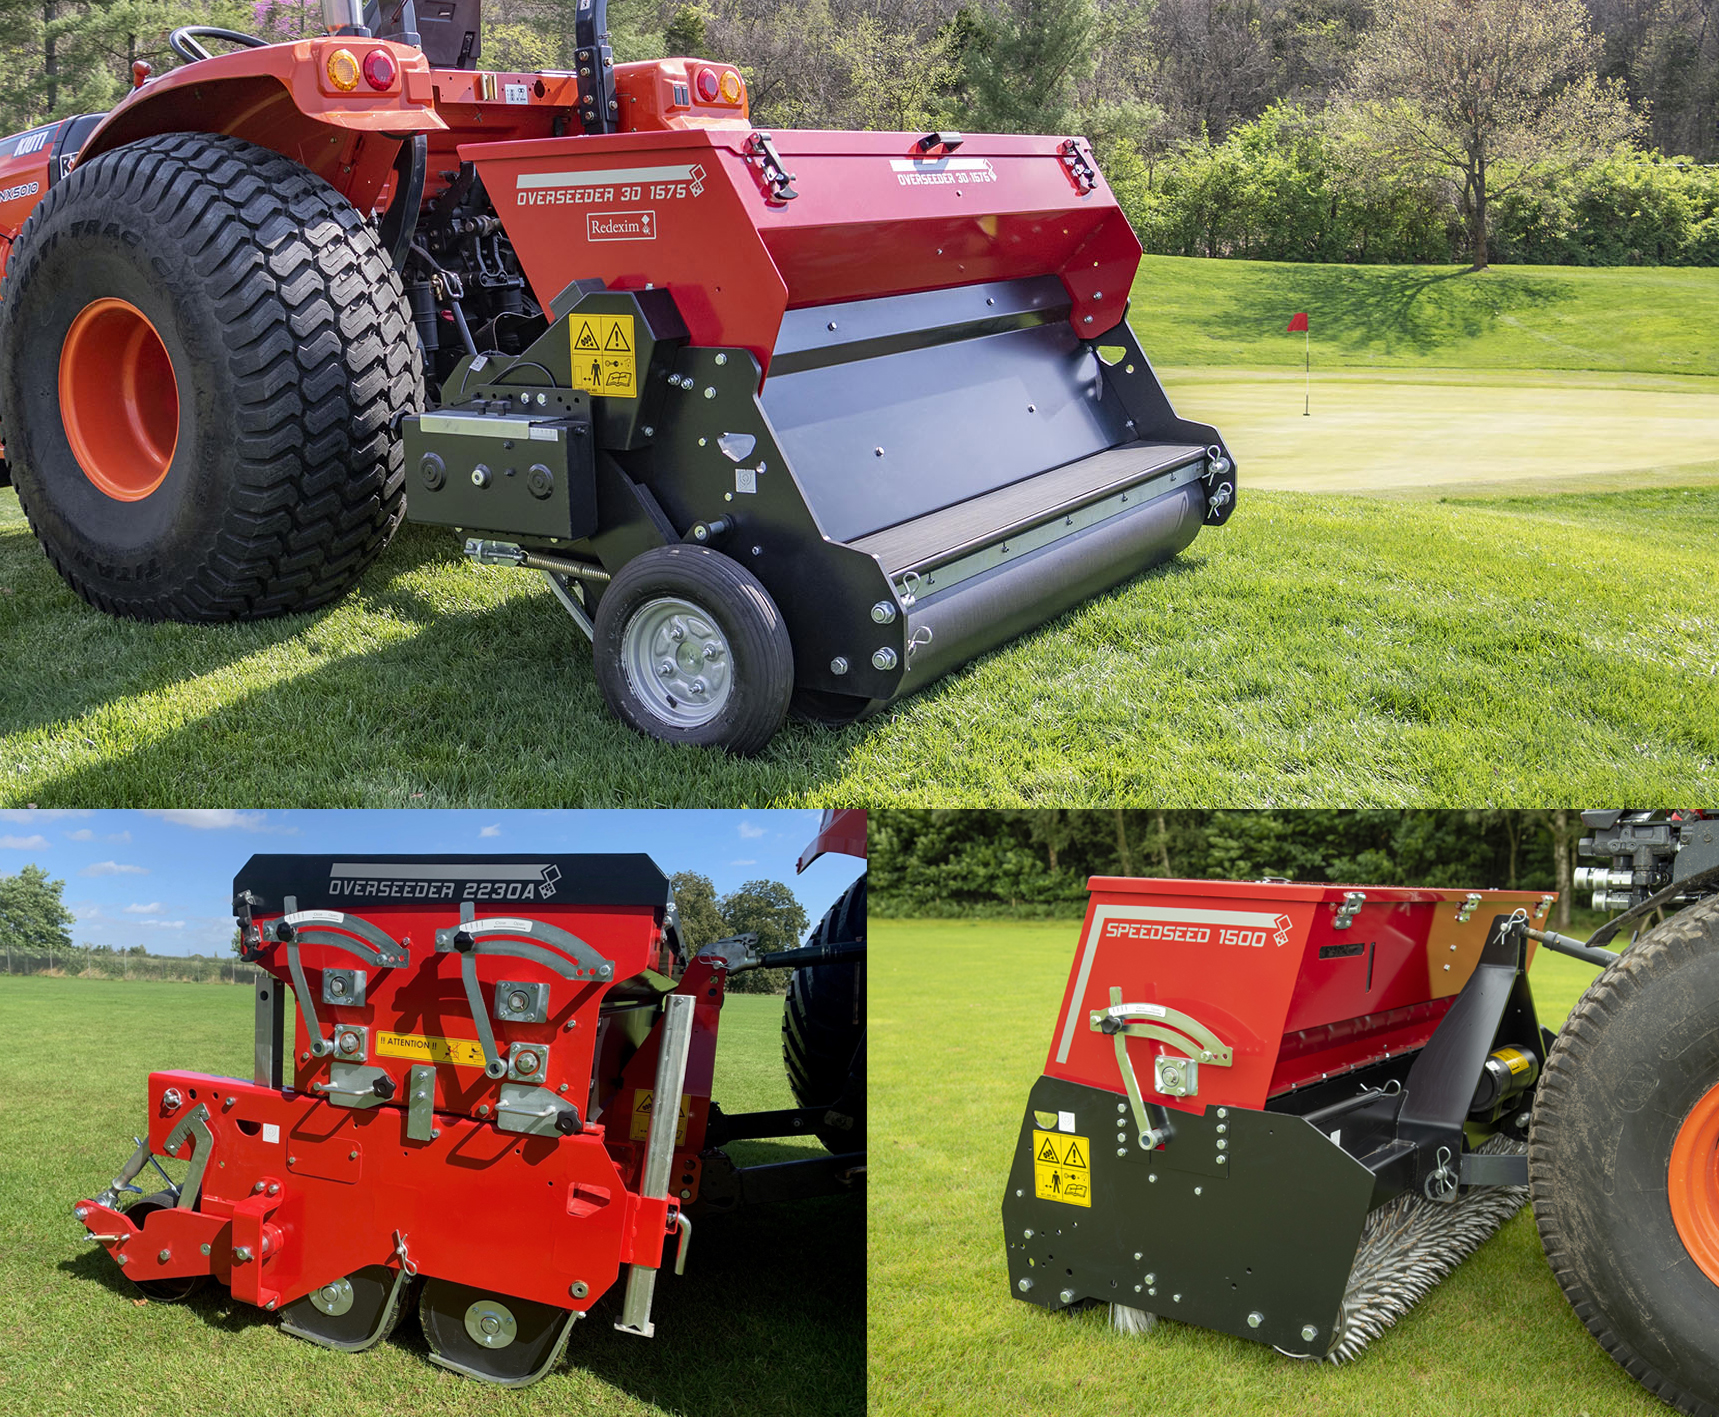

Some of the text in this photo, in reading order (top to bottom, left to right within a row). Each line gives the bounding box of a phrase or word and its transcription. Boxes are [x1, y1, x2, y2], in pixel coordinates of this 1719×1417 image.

[13, 131, 50, 157] KIOTI
[897, 173, 956, 186] OVERSEEDER
[517, 188, 615, 206] OVERSEEDER
[650, 184, 687, 200] 1575
[591, 218, 640, 234] Redexim
[329, 879, 535, 900] OVERSEEDER 2230A
[1105, 922, 1267, 947] SPEEDSEED 1500
[387, 1037, 430, 1049] ATTENTION
